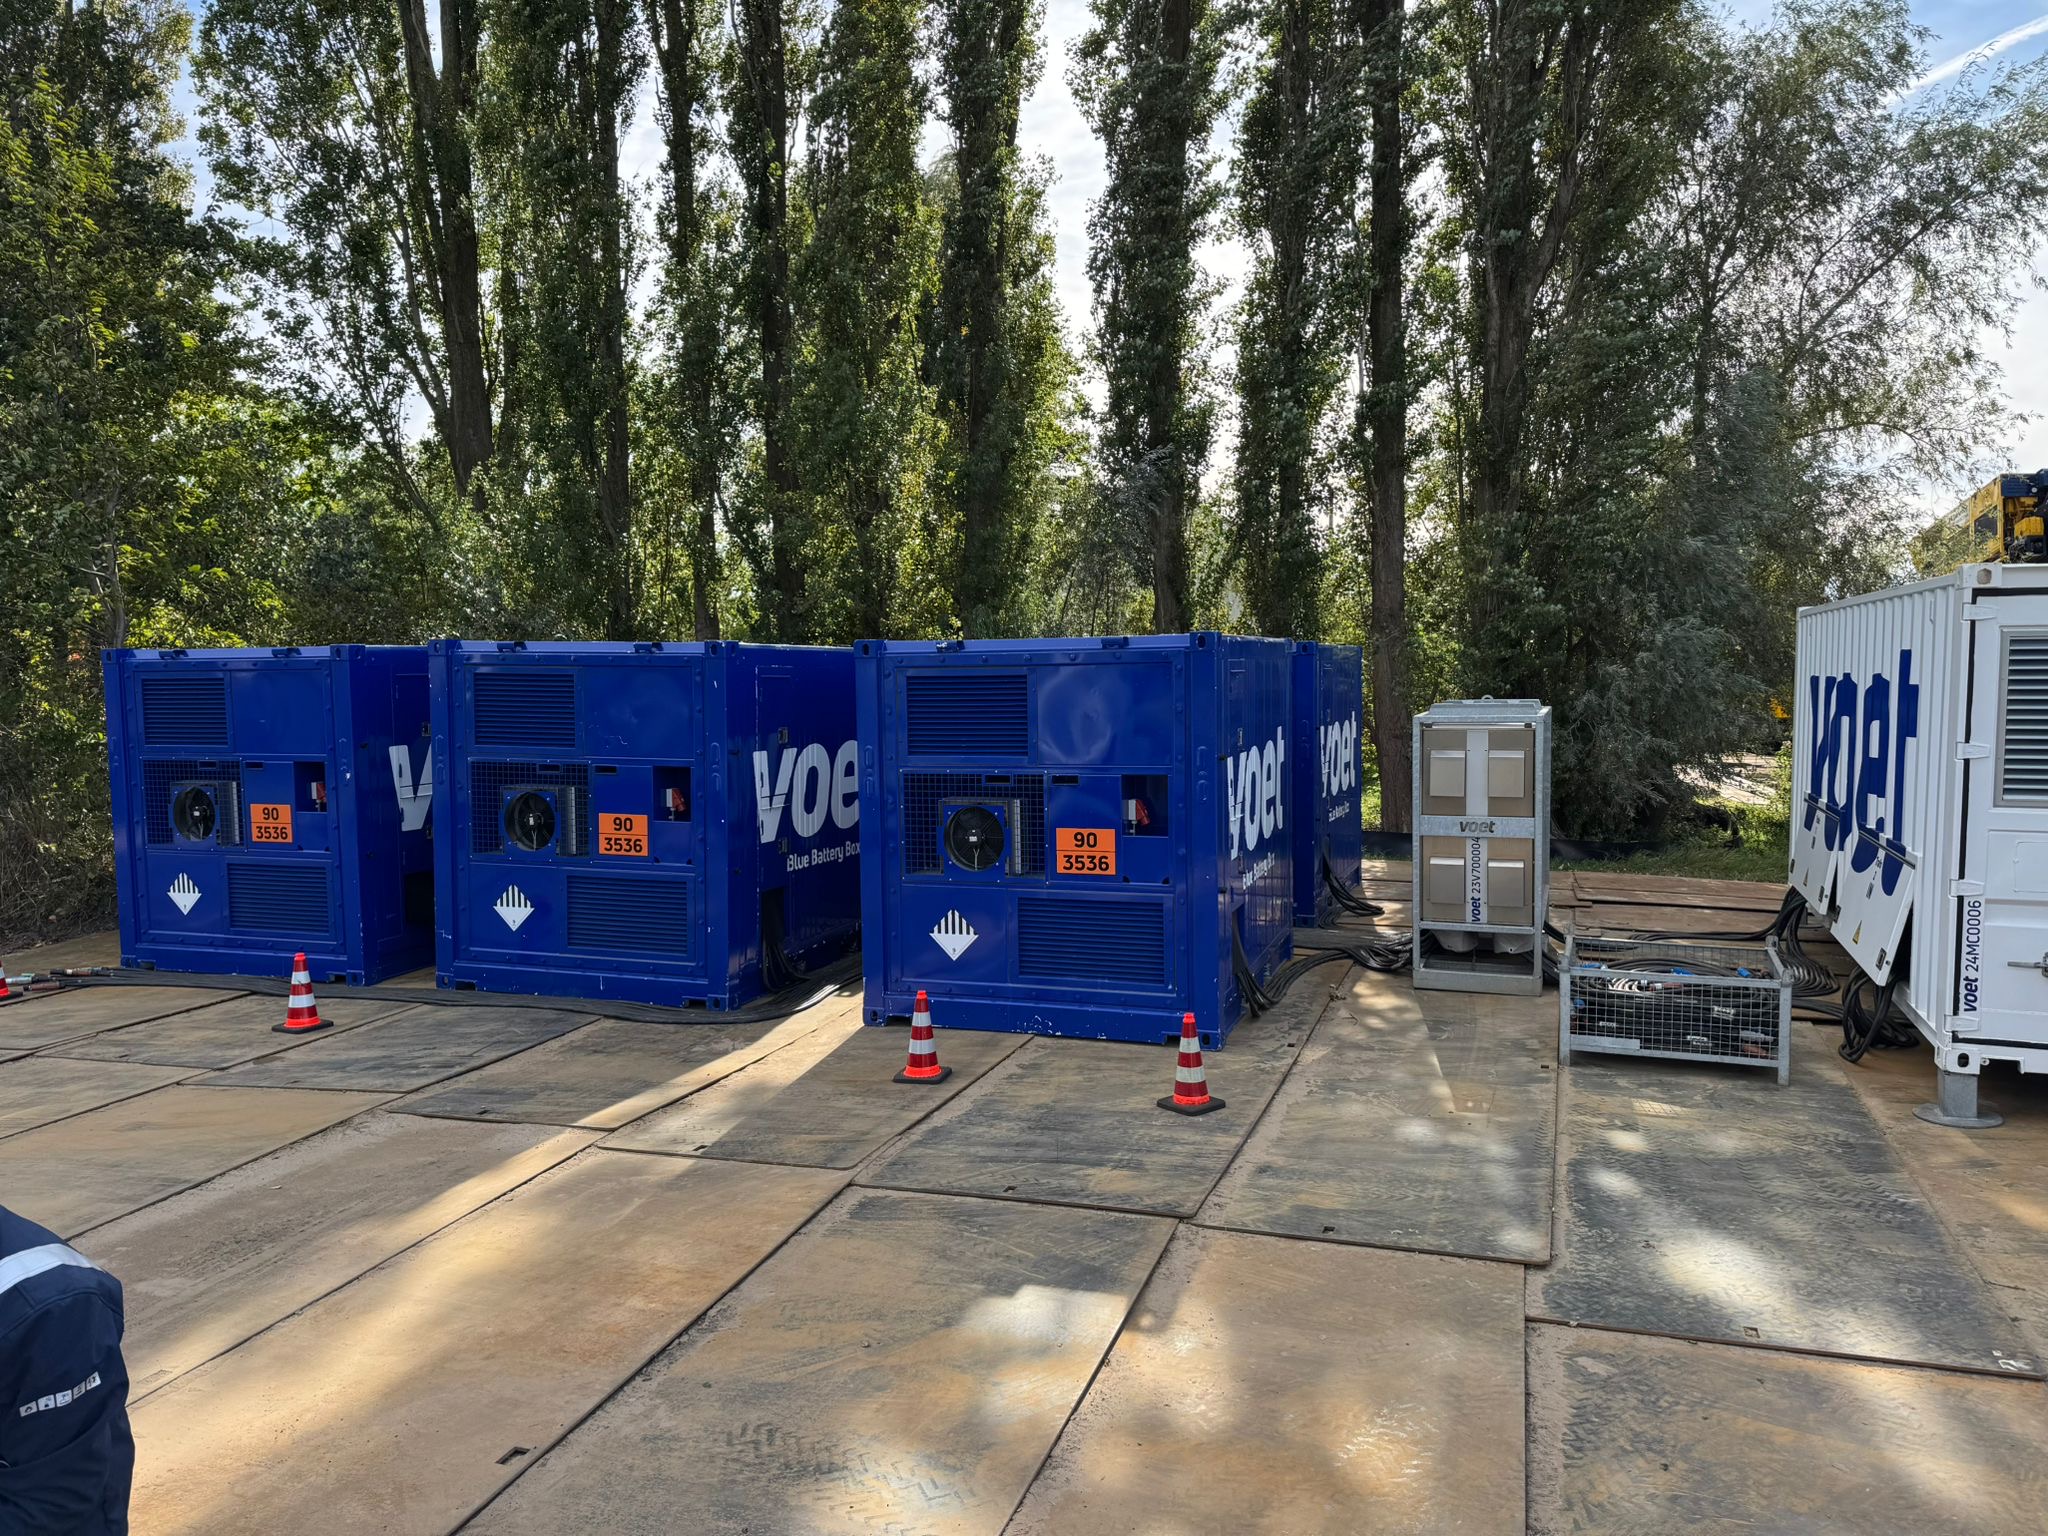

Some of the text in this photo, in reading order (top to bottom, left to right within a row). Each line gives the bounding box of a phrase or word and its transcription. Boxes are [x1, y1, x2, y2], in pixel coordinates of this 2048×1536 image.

[1320, 711, 1356, 798] voet
[1804, 649, 1919, 896] voet
[1227, 726, 1284, 861] voet
[262, 807, 279, 821] 90
[256, 826, 288, 840] 3536
[613, 817, 633, 832] 90
[1460, 821, 1496, 833] voet
[604, 837, 643, 853] 3536
[1073, 831, 1097, 848] 90
[787, 841, 860, 872] Blue Battery Box
[1063, 855, 1109, 871] 3536
[1470, 896, 1481, 923] voet
[1963, 900, 1982, 1012] voet 24MC0006
